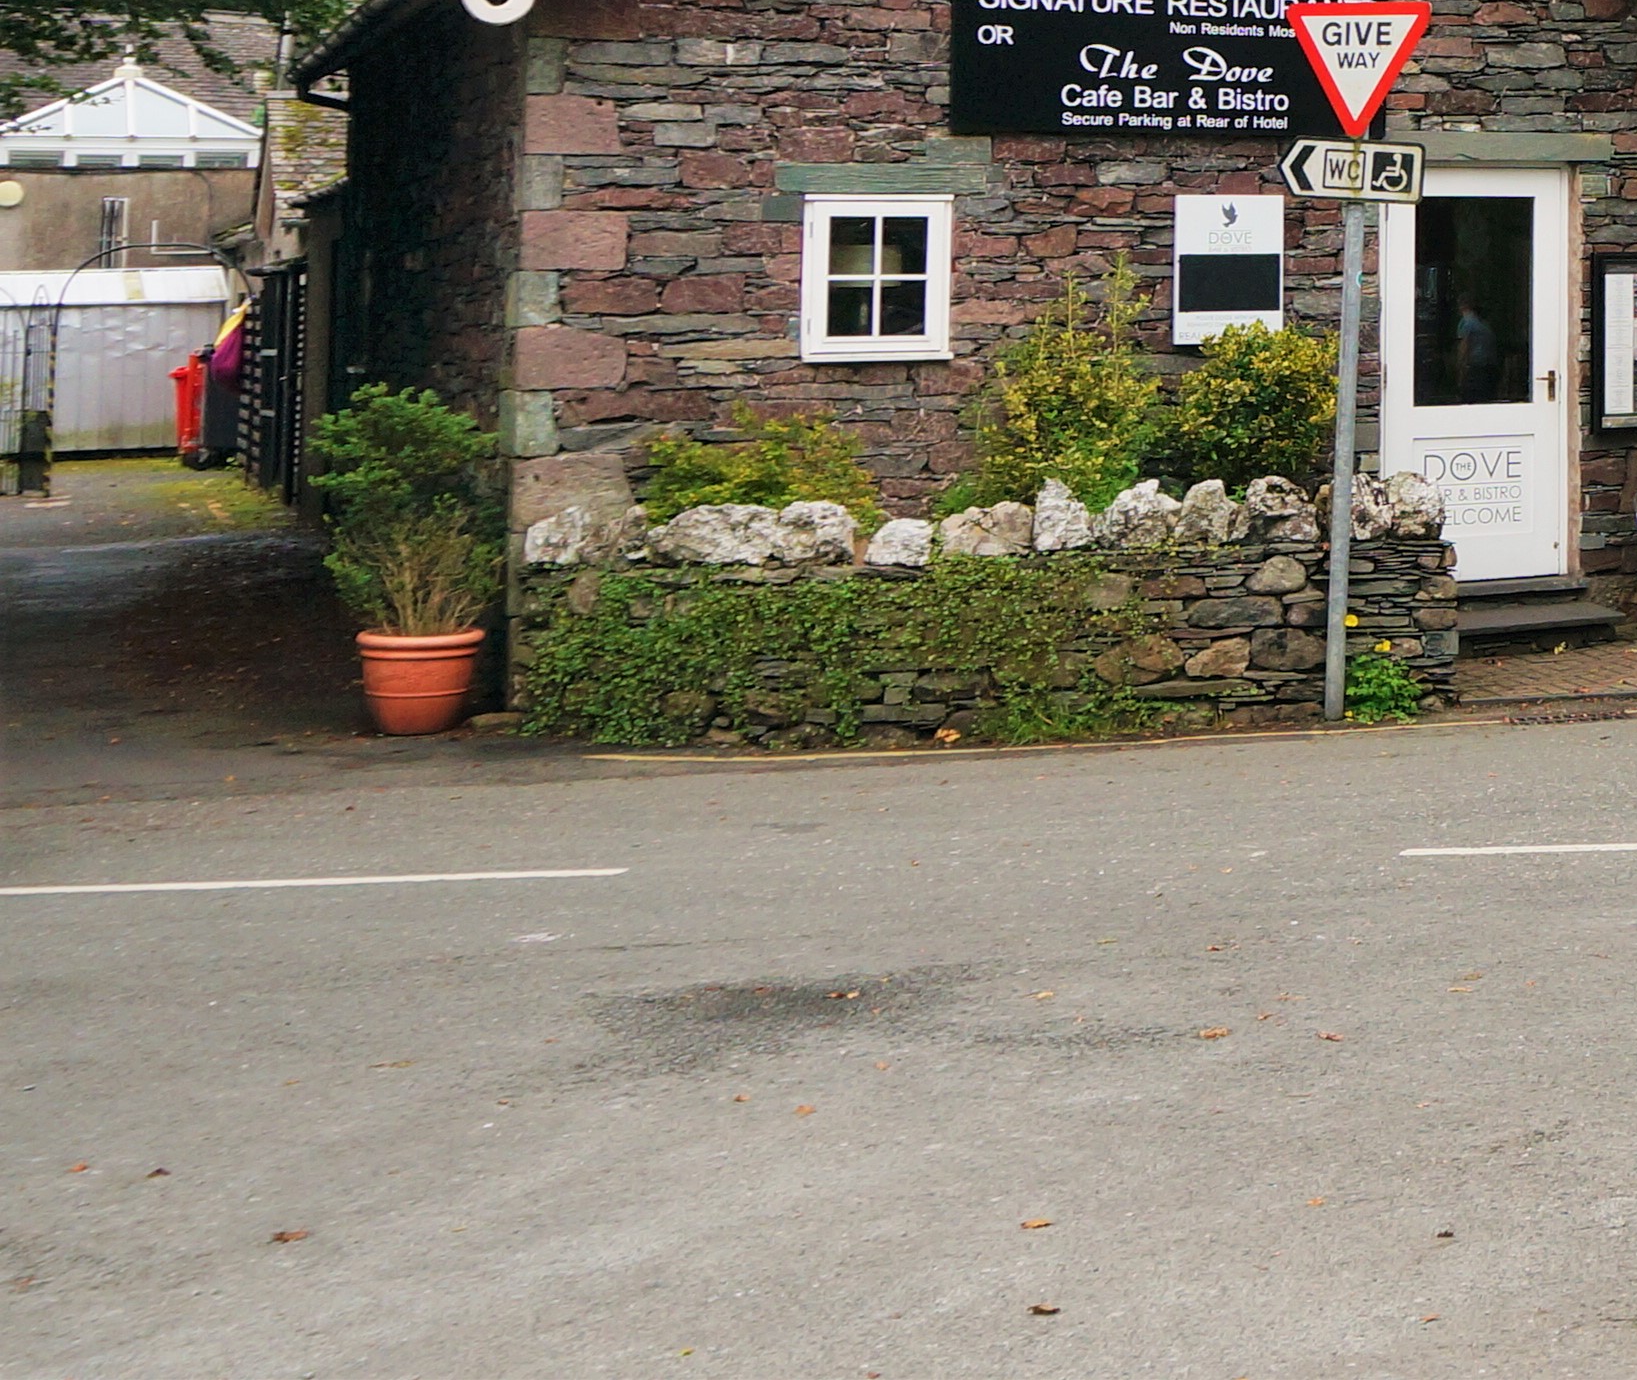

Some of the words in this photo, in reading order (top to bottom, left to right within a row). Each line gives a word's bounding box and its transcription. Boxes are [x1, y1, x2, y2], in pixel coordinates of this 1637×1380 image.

[976, 24, 1015, 46] OR
[1169, 22, 1196, 35] Non
[1201, 23, 1264, 37] Residents
[1269, 24, 1296, 39] Mos
[1322, 22, 1393, 47] GIVE
[1079, 43, 1159, 80] The
[1182, 46, 1274, 82] Dove
[1337, 52, 1381, 70] WAY
[1060, 83, 1124, 108] Cafe
[1133, 85, 1179, 109] Bar
[1188, 86, 1208, 110] &
[1218, 87, 1290, 112] Bistro
[1061, 112, 1114, 126] Secure
[1118, 113, 1172, 130] Parking
[1176, 114, 1192, 128] at
[1196, 114, 1231, 129] Rear
[1234, 115, 1250, 129] of
[1252, 115, 1289, 130] Hotel
[1329, 158, 1360, 183] WC
[1209, 231, 1252, 245] DOVE
[1424, 451, 1522, 481] DOVE
[1455, 462, 1472, 472] THE
[1458, 488, 1468, 501] &
[1473, 485, 1522, 501] BISTRO
[1443, 506, 1522, 526] ELCOME
